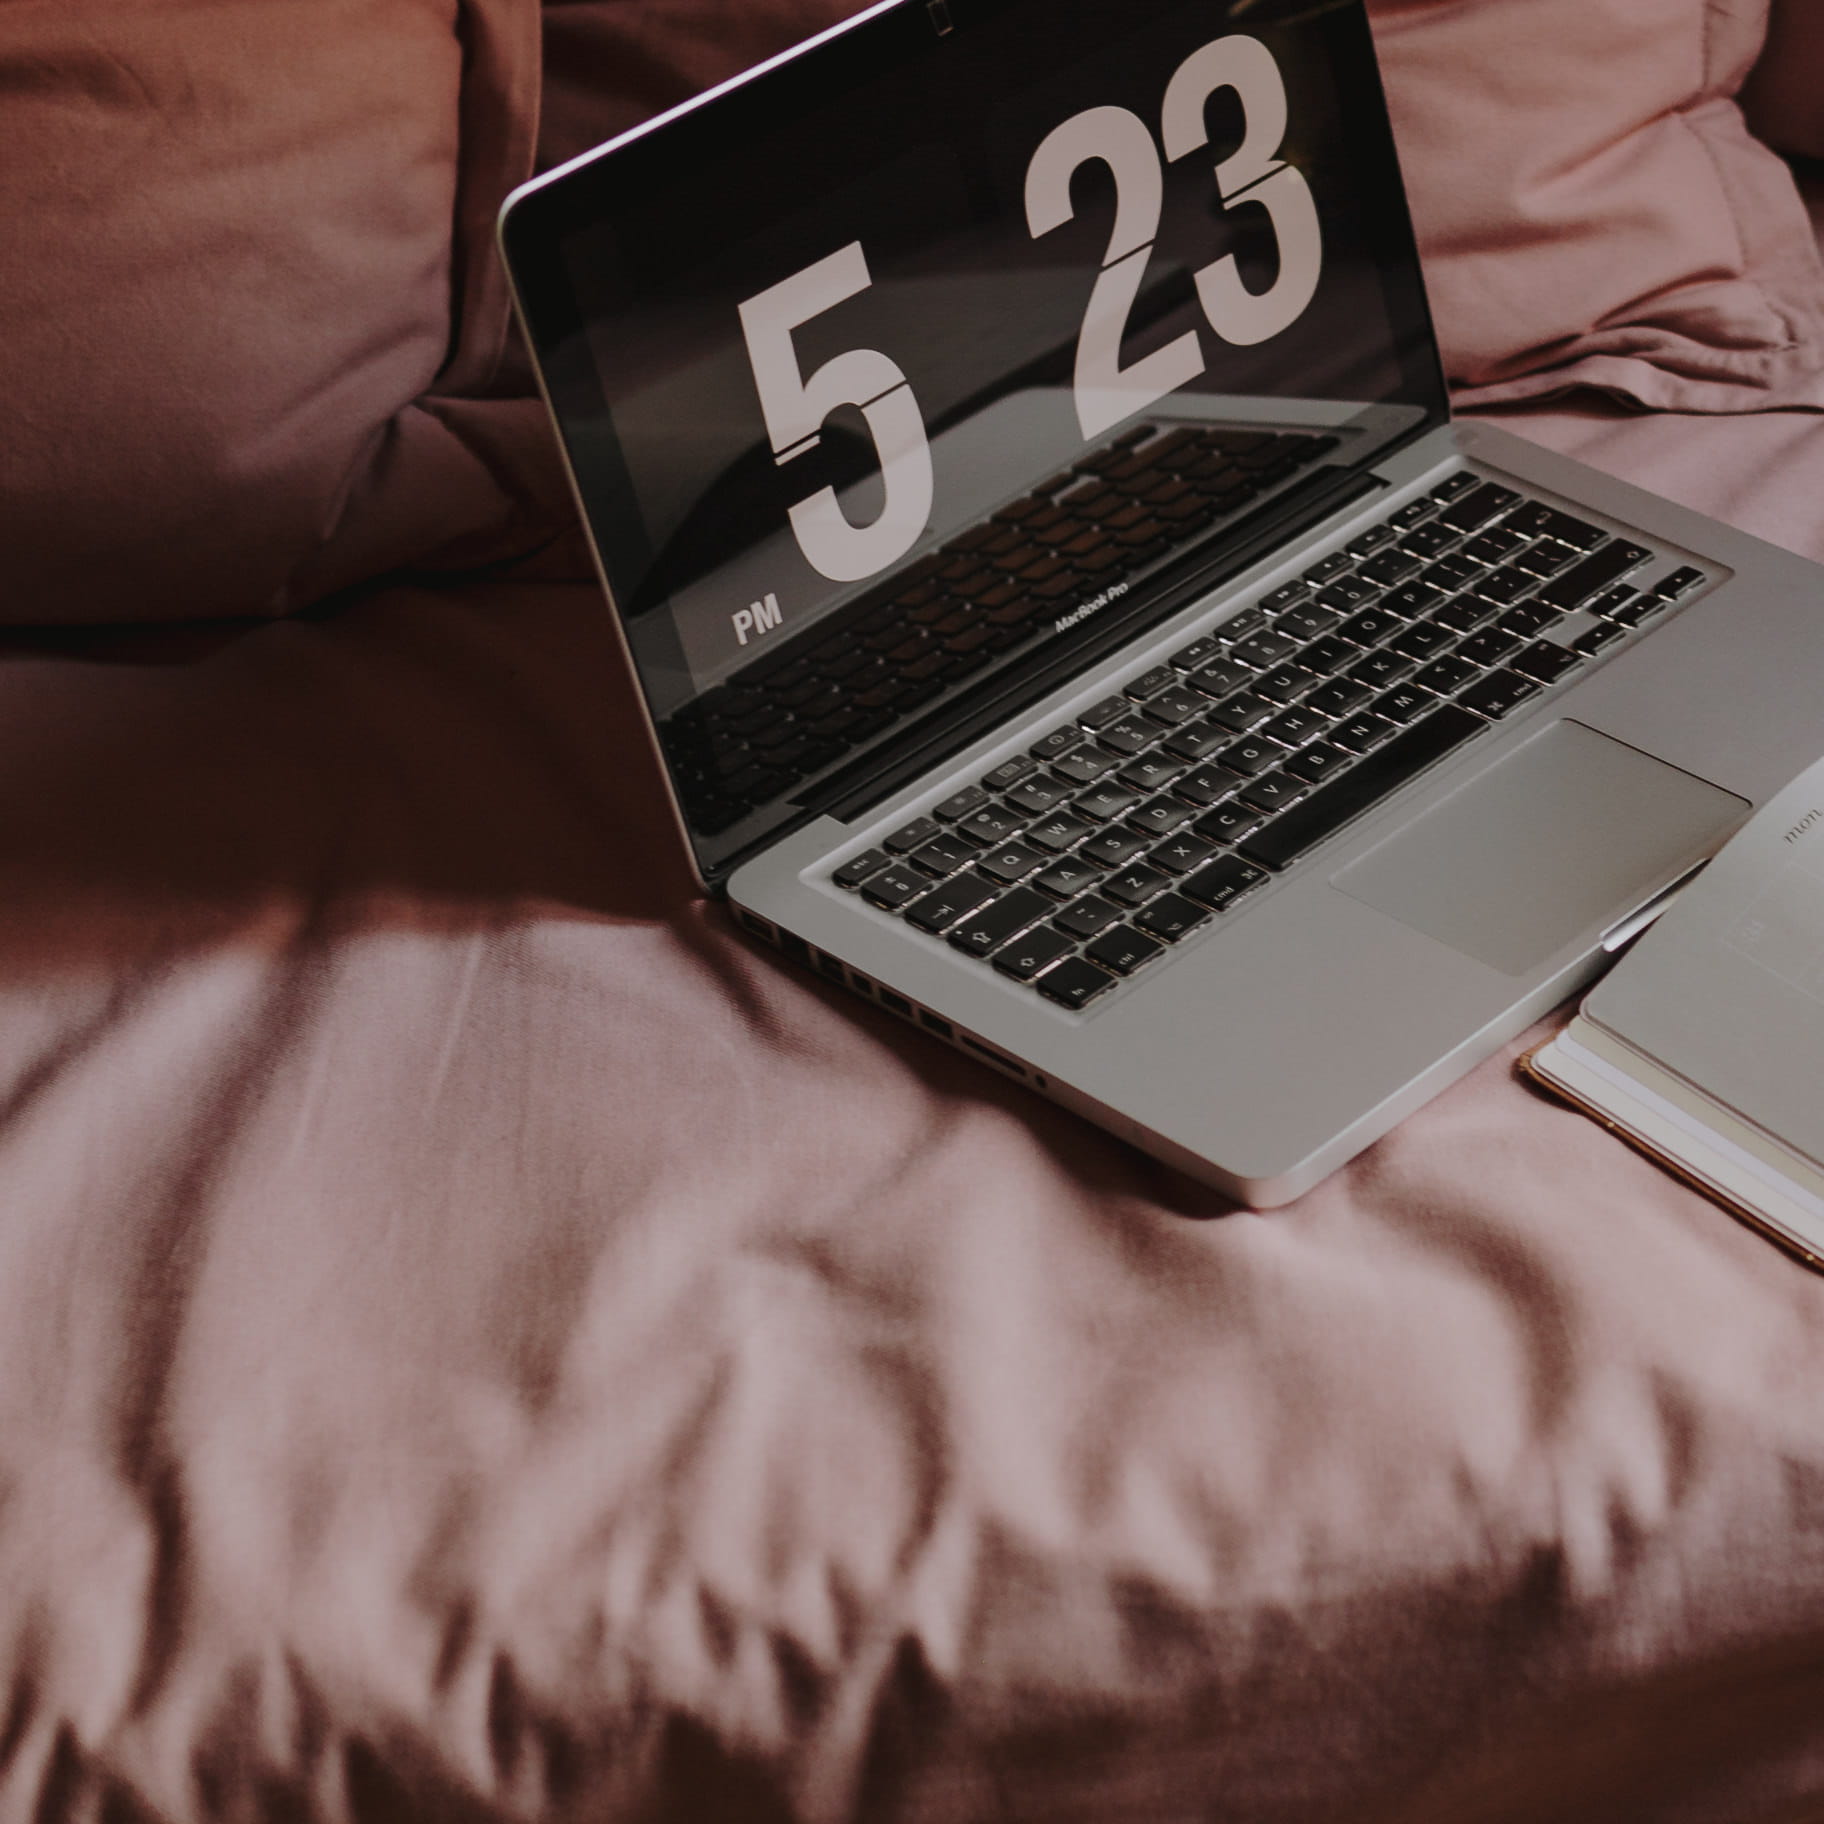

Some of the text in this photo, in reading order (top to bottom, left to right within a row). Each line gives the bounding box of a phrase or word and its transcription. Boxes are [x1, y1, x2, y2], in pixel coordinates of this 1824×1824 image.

[738, 34, 1322, 581] 5 23
[1055, 582, 1129, 633] MacBook Pro
[732, 592, 784, 647] PM
[1361, 621, 1377, 630] O
[1371, 662, 1390, 672] K
[1274, 676, 1291, 686] U
[1393, 696, 1415, 708] M
[1231, 705, 1246, 714] Y
[1285, 718, 1303, 730] H
[1351, 726, 1369, 736] N
[1187, 734, 1201, 743] T
[1308, 756, 1325, 765] B
[1142, 764, 1159, 774] R
[1197, 777, 1211, 788] F
[1263, 784, 1279, 795] V
[1097, 794, 1112, 804] E
[1151, 809, 1167, 818] D
[1220, 815, 1236, 825] C
[1047, 823, 1067, 835] W
[1782, 807, 1824, 847] mon
[1106, 839, 1120, 848] S
[1172, 846, 1190, 857] X
[1060, 871, 1076, 881] A
[1126, 877, 1144, 888] Z
